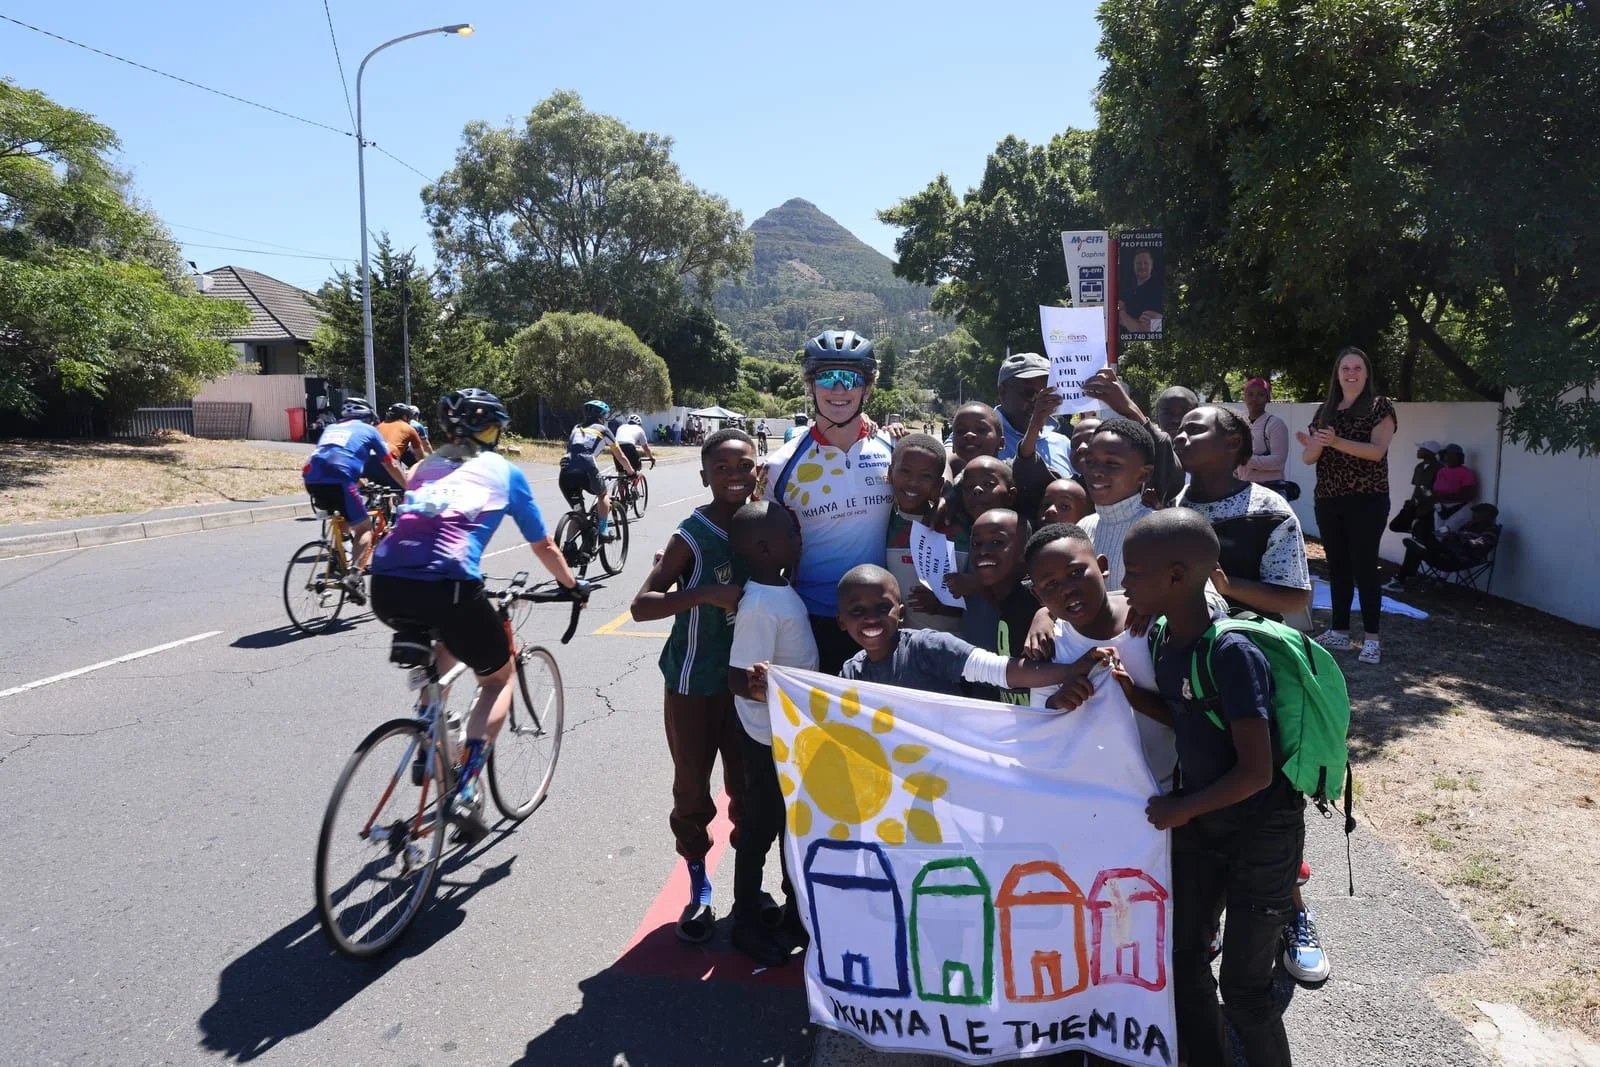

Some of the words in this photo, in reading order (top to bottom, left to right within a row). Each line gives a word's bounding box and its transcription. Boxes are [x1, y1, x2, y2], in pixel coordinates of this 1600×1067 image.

[1059, 368, 1077, 376] FOR
[802, 502, 837, 517] IKHAYA
[846, 498, 857, 508] LE
[829, 996, 930, 1038] IKHAYA
[939, 1013, 993, 1055] LE
[1002, 1008, 1171, 1066] THEMBA
